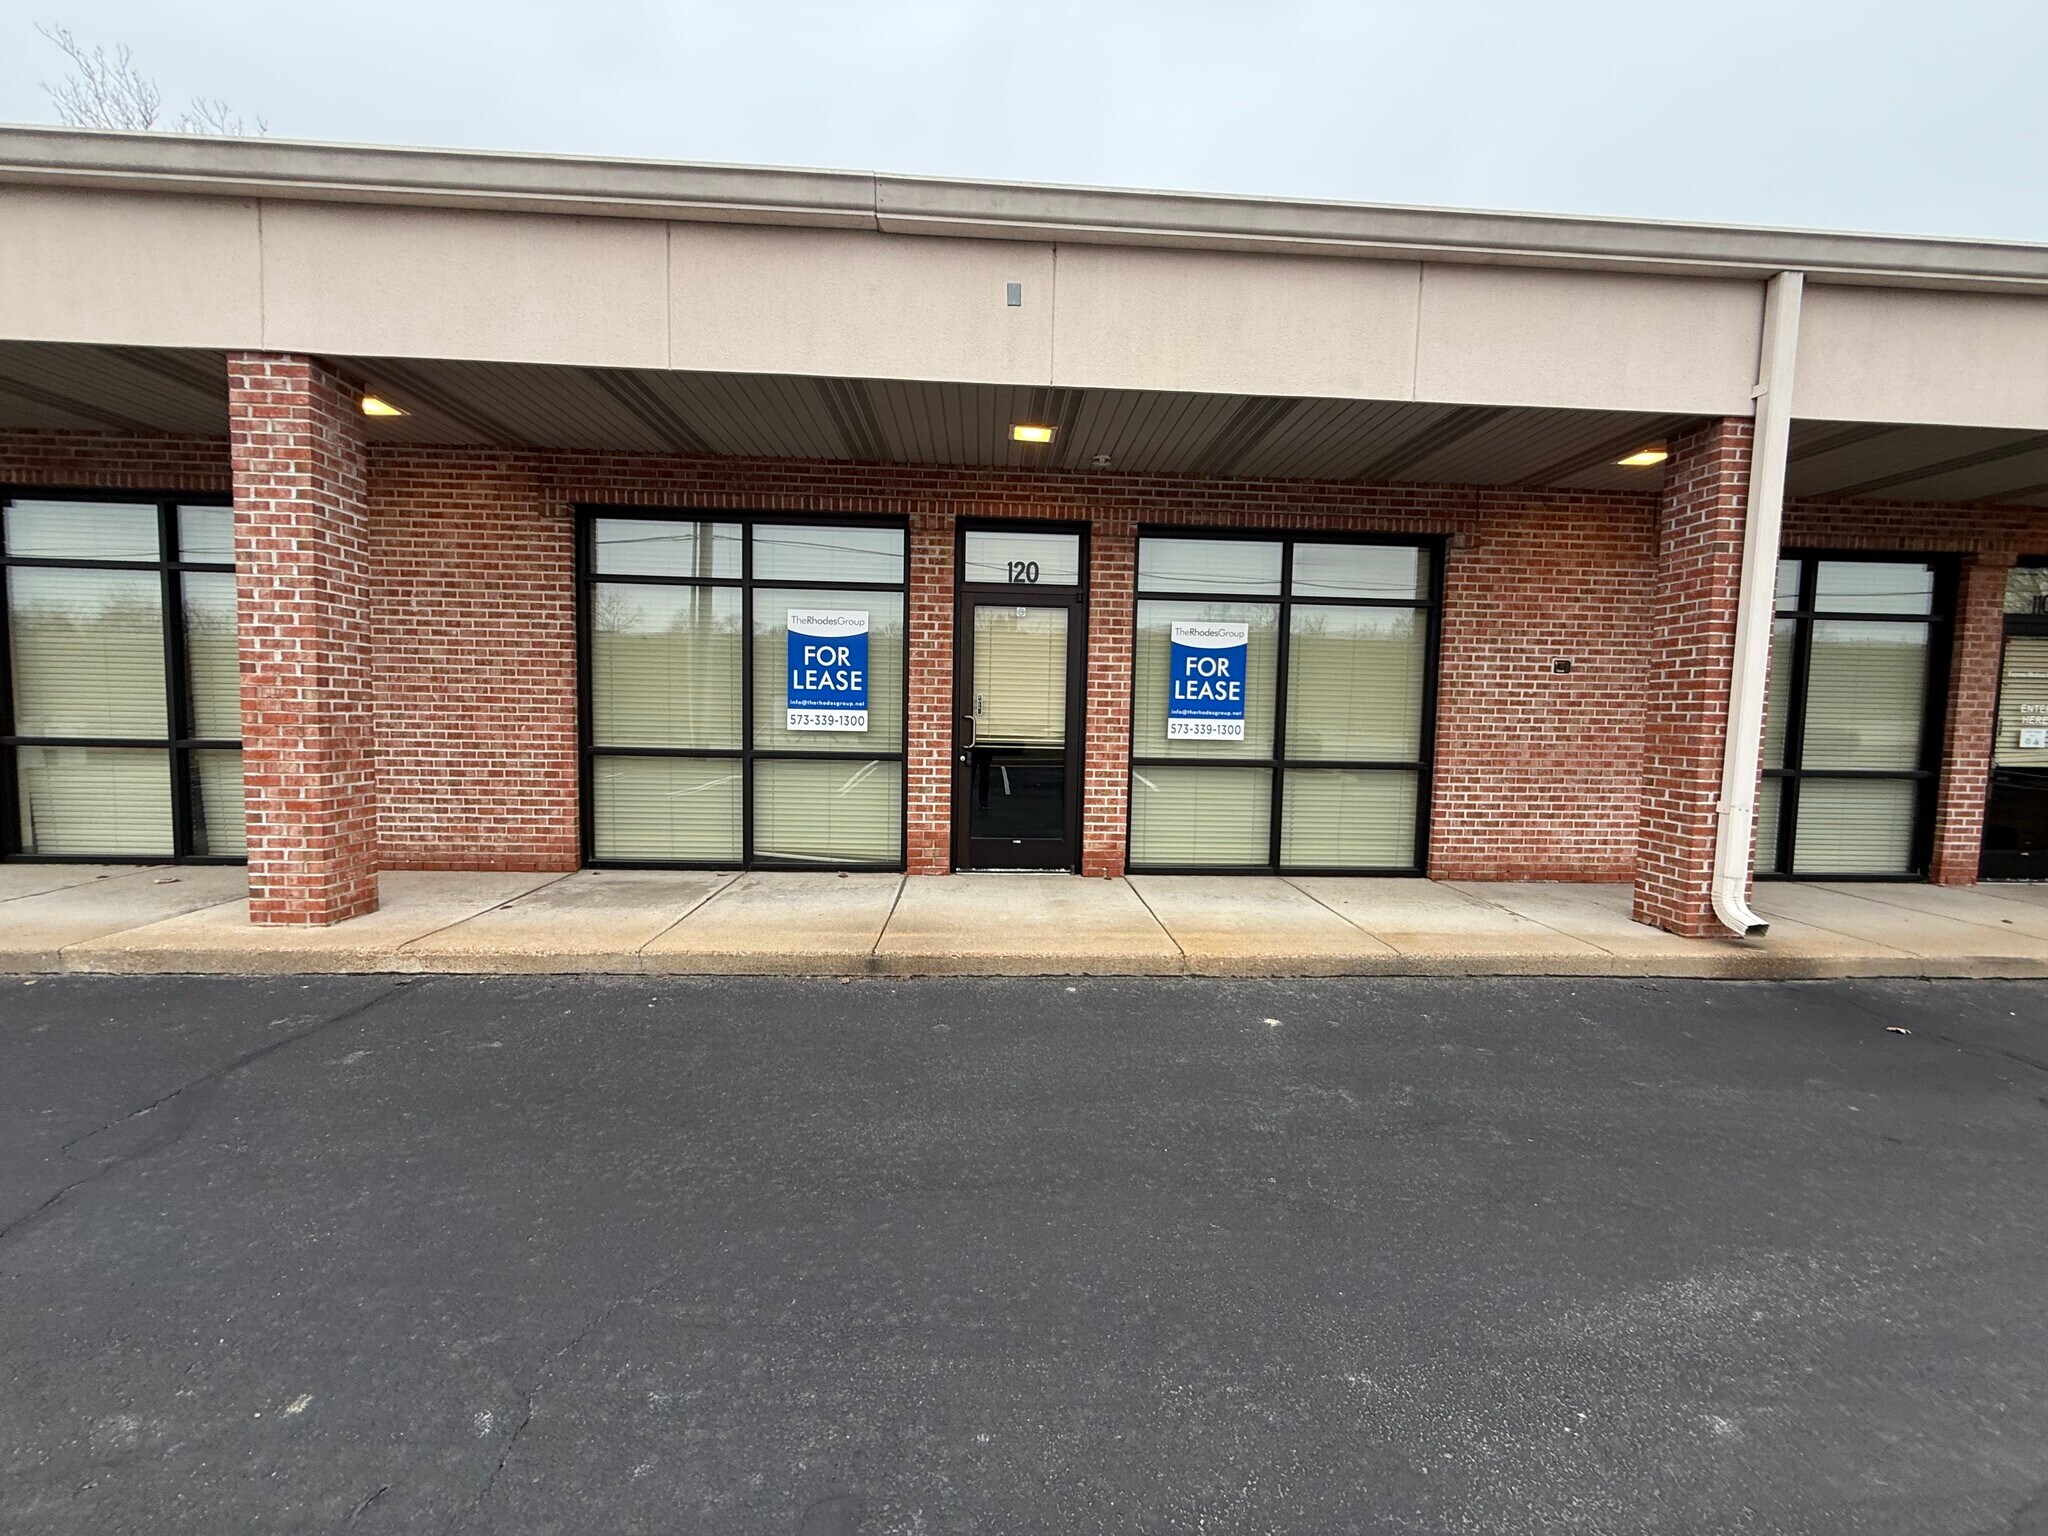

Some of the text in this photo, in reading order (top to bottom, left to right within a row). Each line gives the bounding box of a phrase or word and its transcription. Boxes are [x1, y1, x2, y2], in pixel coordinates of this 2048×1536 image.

[1007, 561, 1040, 583] 120
[791, 615, 865, 627] TheRhodesGroup
[1175, 627, 1244, 639] TheRhodesGroup
[804, 646, 851, 666] FOR
[1186, 657, 1230, 677] FOR
[793, 669, 862, 691] LEASE
[1174, 680, 1240, 701] LEASE
[2021, 704, 2048, 713] ENTE
[790, 714, 865, 726] 573-339-1300
[1171, 723, 1241, 735] 573-339-1300
